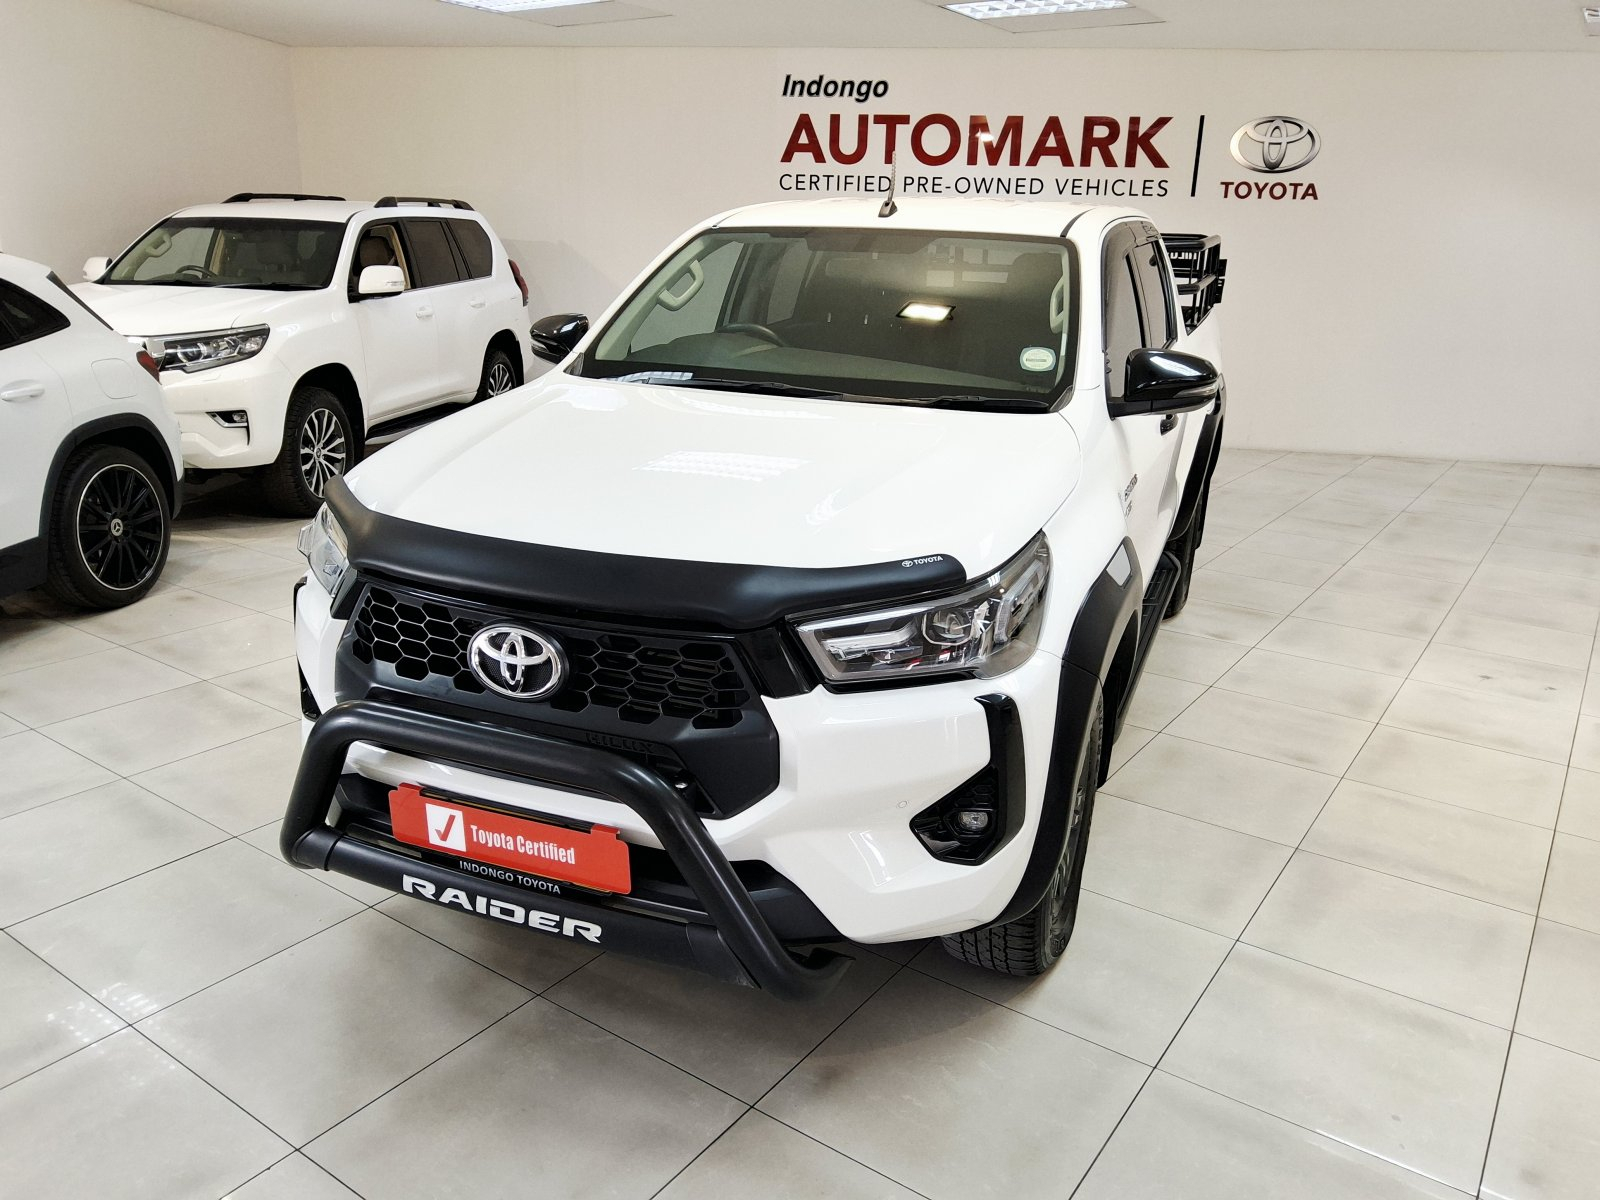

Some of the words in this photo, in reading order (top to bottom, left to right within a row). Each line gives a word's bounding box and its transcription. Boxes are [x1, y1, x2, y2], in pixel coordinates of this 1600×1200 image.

[782, 74, 889, 103] Indongo
[780, 113, 1174, 169] AUTOMARK
[779, 173, 892, 193] CERTIFIED
[903, 176, 1044, 195] PRE-OWNED
[1055, 178, 1169, 197] VEHICLES
[1220, 181, 1319, 200] TOYOTA
[914, 555, 943, 566] TOYOTA
[470, 824, 515, 851] Toyota
[516, 835, 576, 865] Certified
[459, 860, 514, 882] INDONGO
[516, 875, 561, 895] TOYOTA
[402, 874, 603, 944] RAIDER
